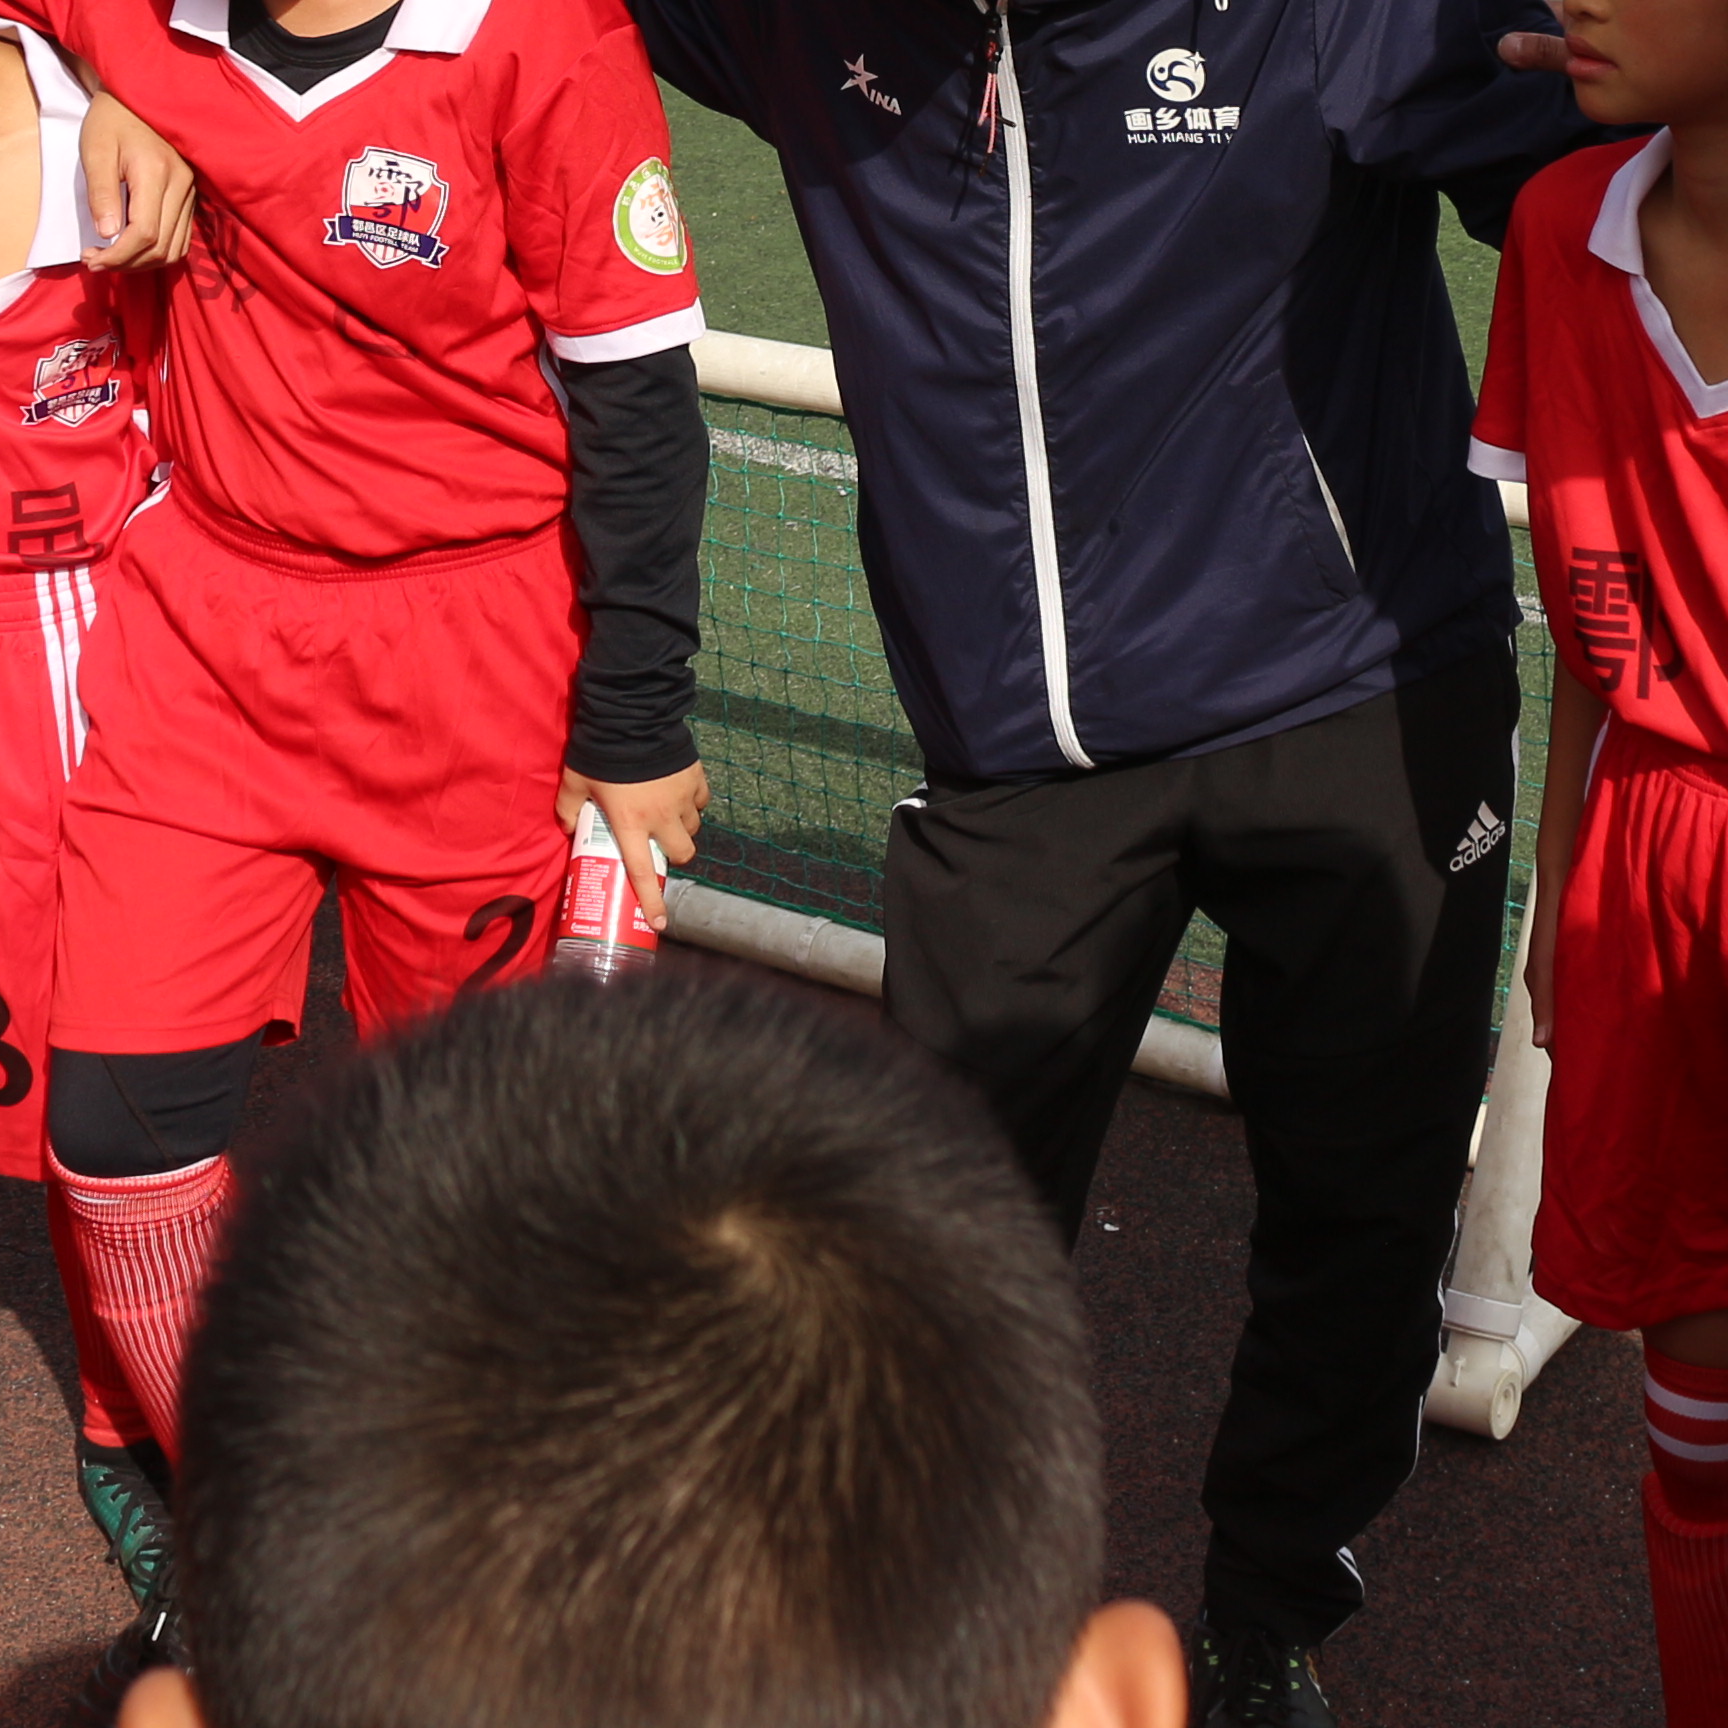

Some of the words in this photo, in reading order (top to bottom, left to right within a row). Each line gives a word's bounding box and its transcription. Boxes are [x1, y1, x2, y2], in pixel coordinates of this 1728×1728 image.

[1124, 106, 1241, 131] 画乡体育
[1127, 133, 1158, 144] HUA
[1162, 132, 1204, 144] XIANG
[1208, 133, 1222, 144] TI
[1449, 820, 1506, 872] adidas
